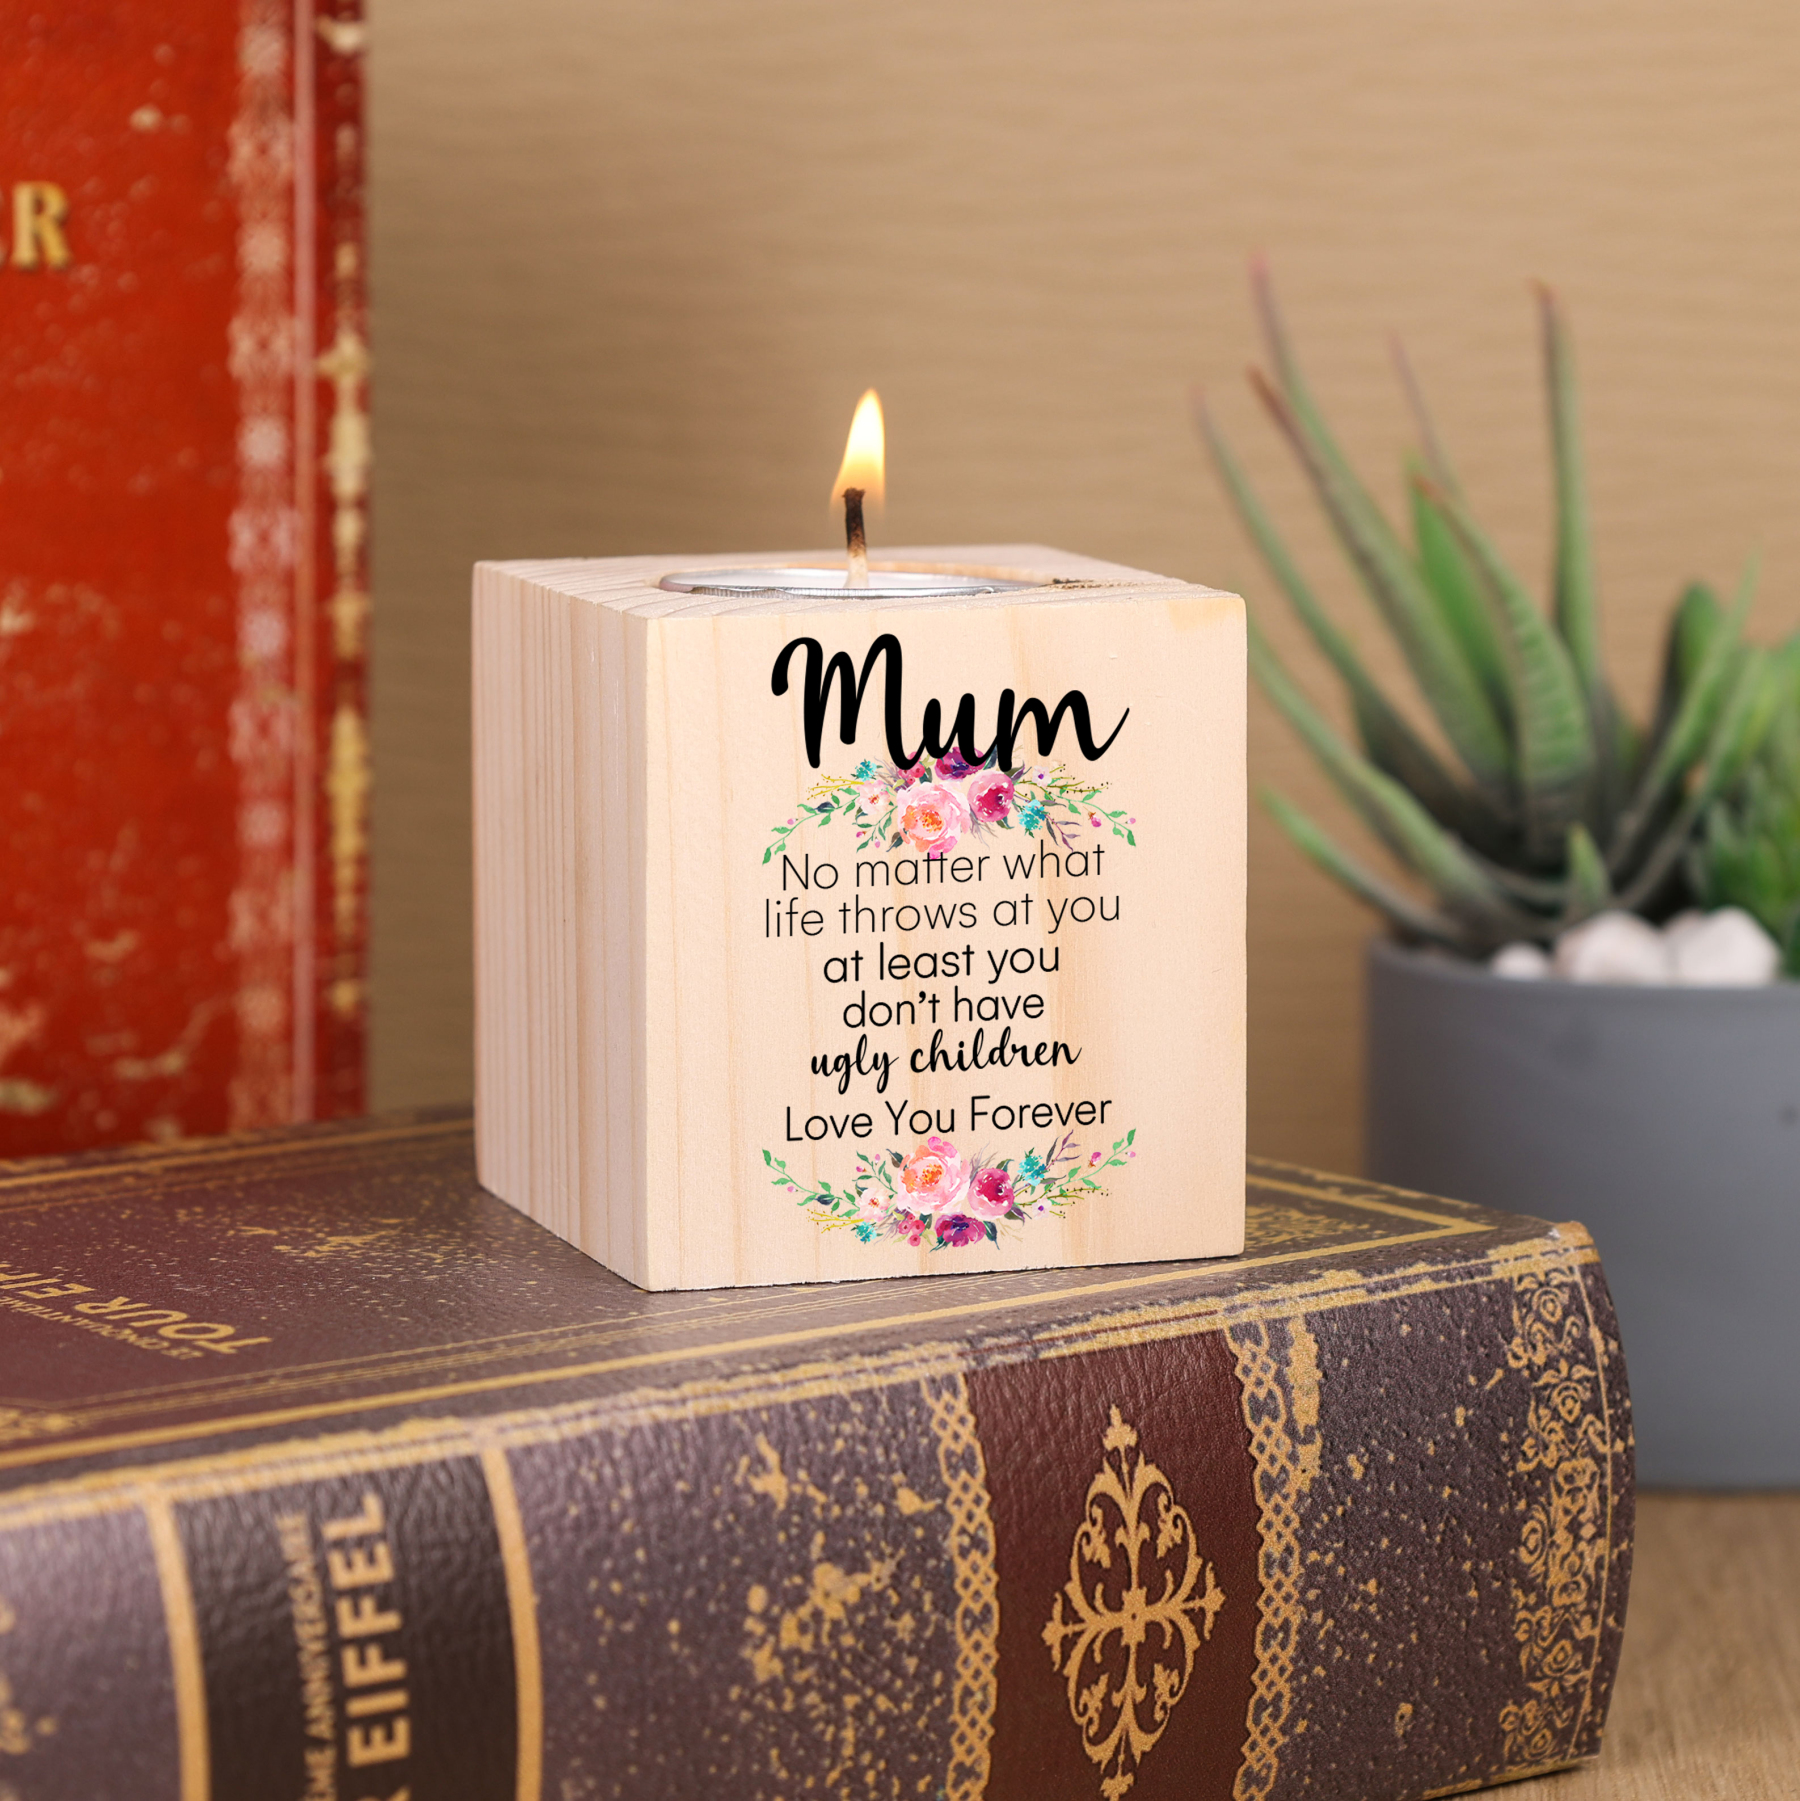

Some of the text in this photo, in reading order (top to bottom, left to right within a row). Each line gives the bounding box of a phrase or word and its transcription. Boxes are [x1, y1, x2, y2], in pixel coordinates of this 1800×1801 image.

[771, 633, 1130, 771] Mum
[782, 839, 1105, 891] No matter what
[765, 893, 1120, 938] life throws at you
[823, 941, 1059, 985] at least you
[843, 985, 1044, 1029] don’t have
[811, 1026, 1082, 1095] ugly children
[786, 1095, 1112, 1142] Love You Forever
[74, 1296, 273, 1354] TOUR
[321, 1492, 412, 1767] EIFFEL
